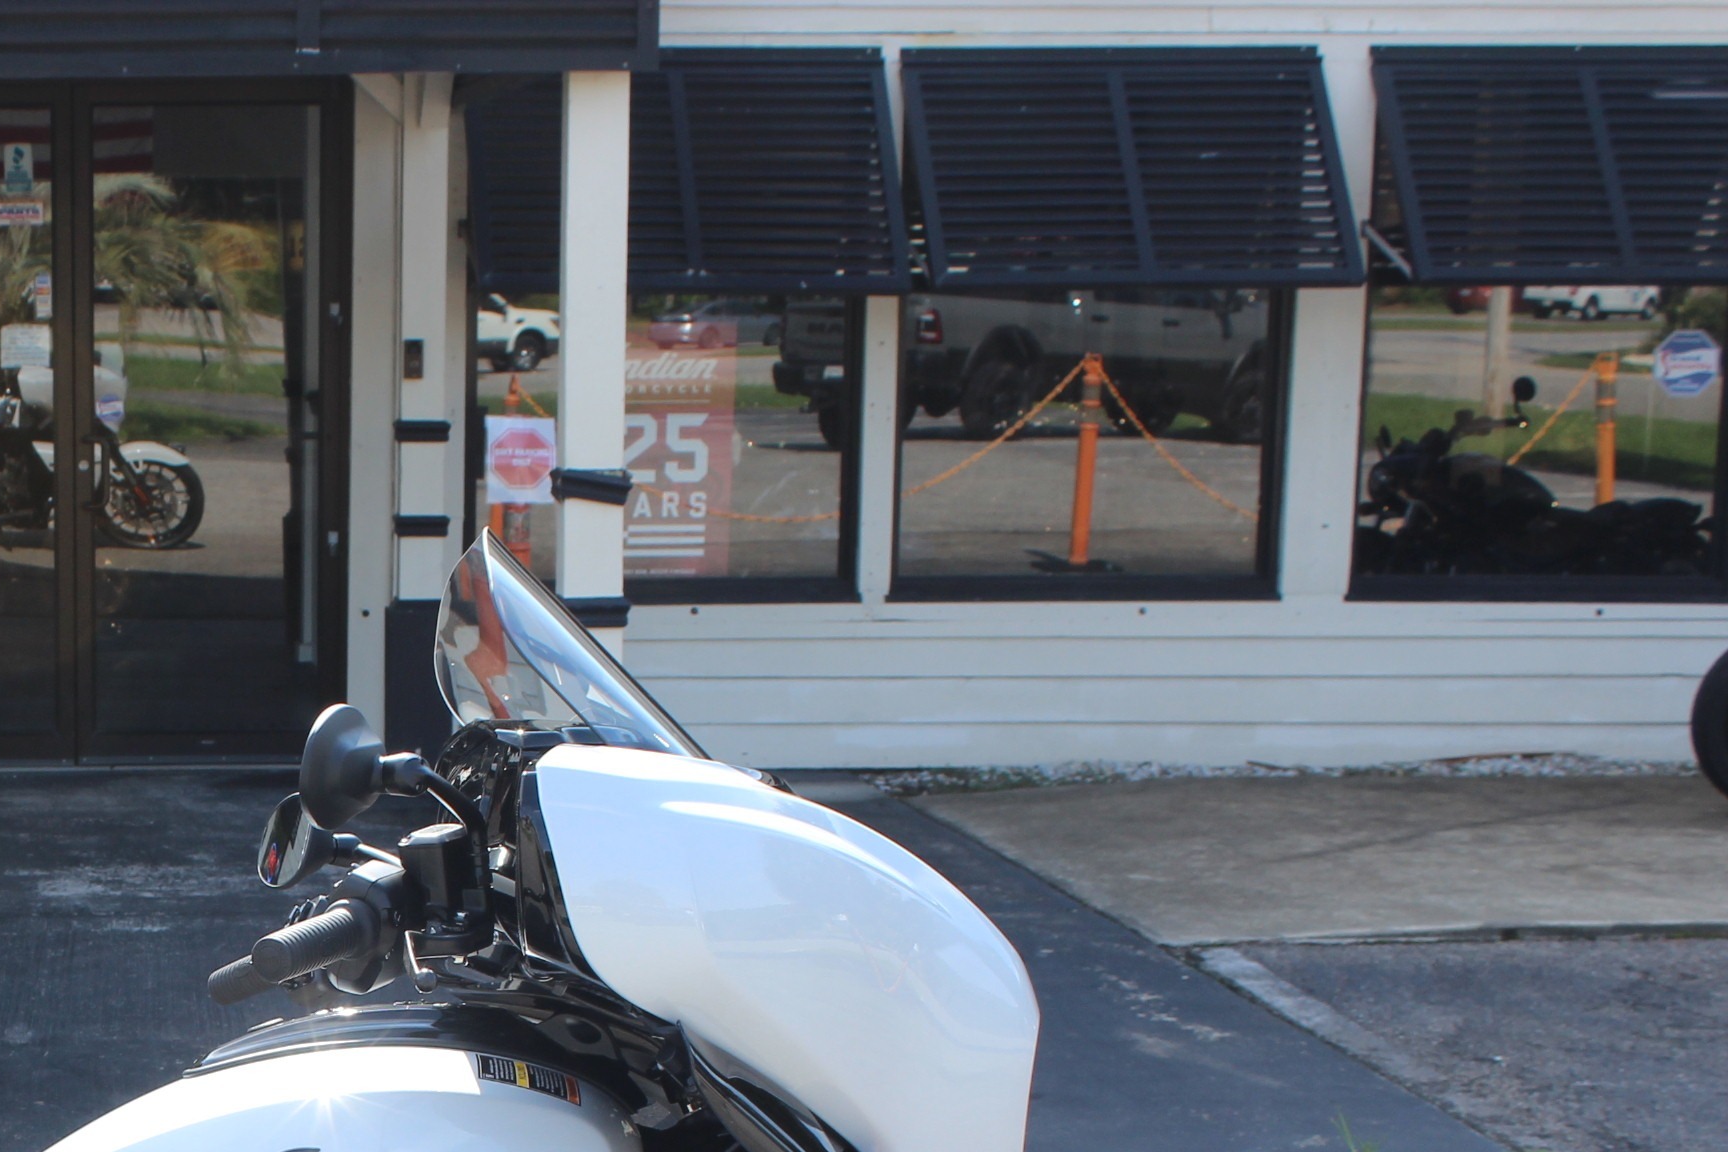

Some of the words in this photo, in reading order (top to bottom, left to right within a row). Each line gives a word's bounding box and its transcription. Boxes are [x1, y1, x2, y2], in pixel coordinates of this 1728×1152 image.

[625, 349, 718, 380] ndian
[625, 384, 714, 395] ORCYCLE
[624, 412, 710, 484] 25
[633, 491, 708, 519] ARS
